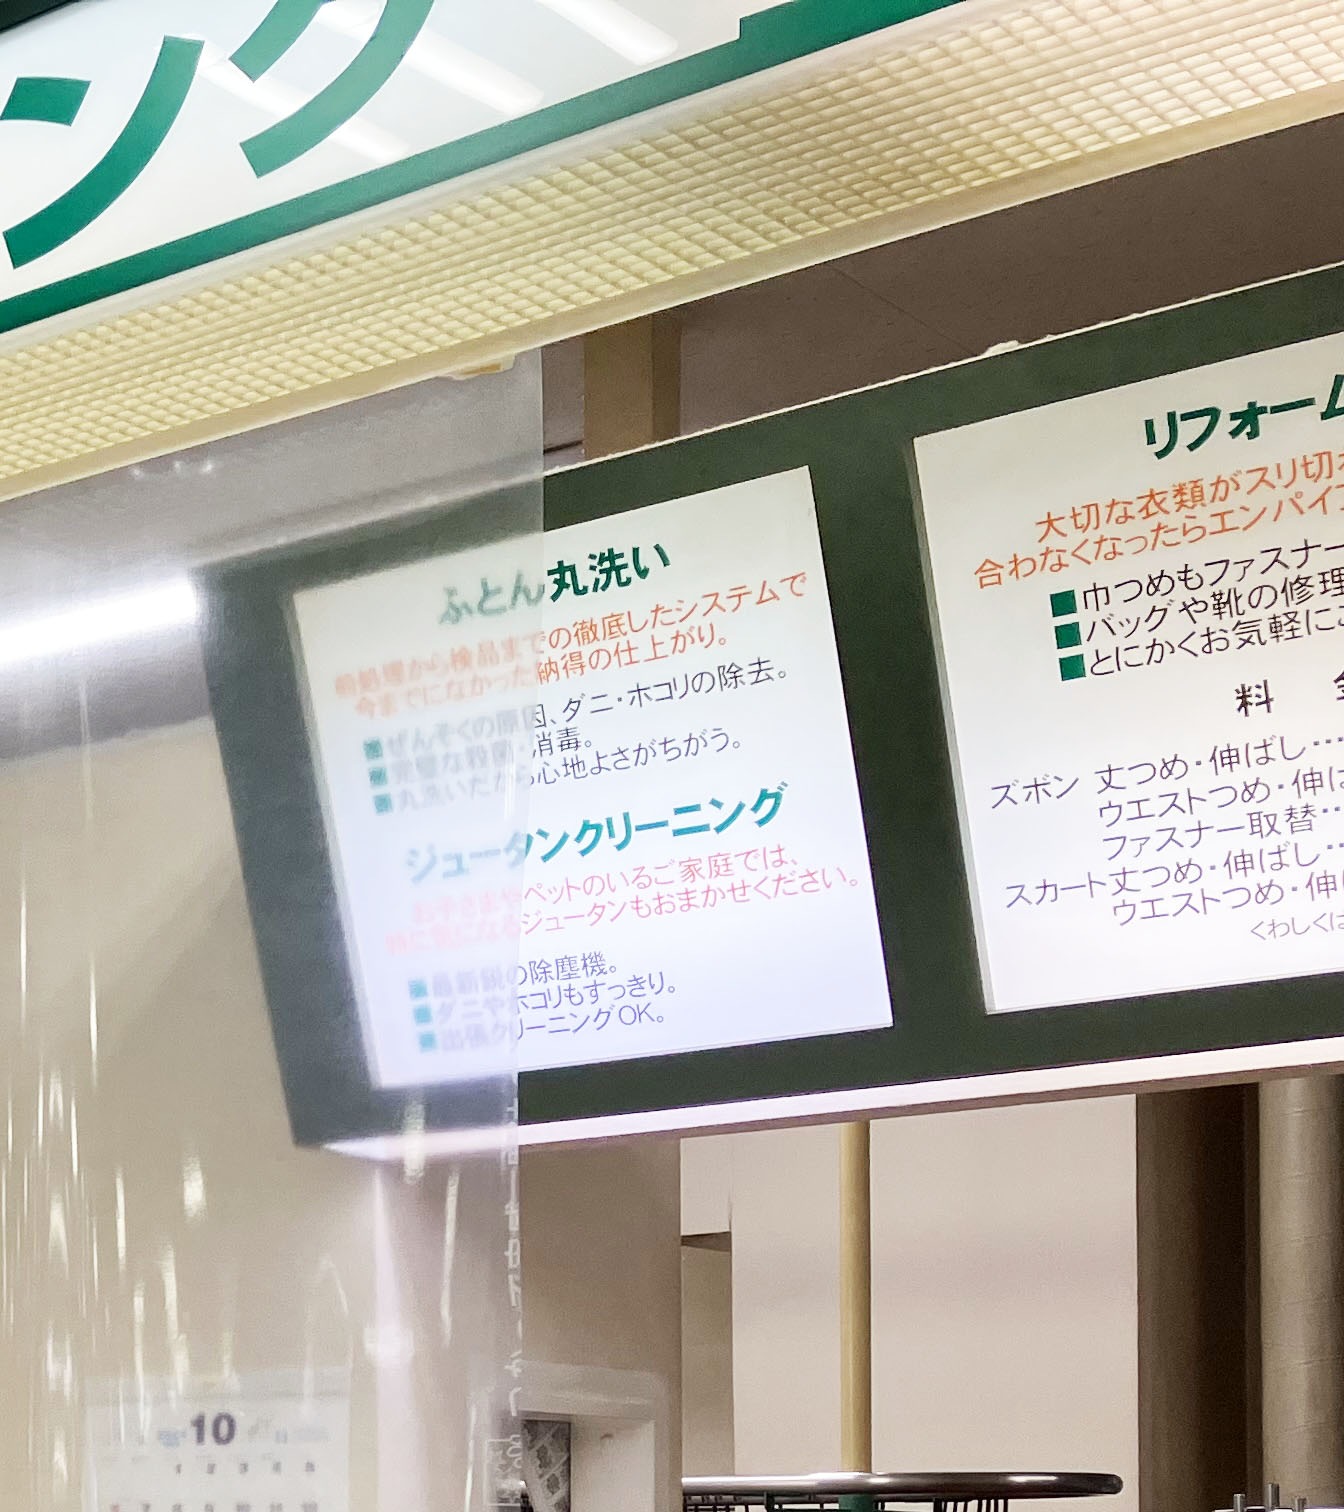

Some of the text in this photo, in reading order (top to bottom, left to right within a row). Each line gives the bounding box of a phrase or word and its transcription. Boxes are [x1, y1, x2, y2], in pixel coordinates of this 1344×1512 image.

[1036, 450, 1344, 545] 大切な衣類がスリ切
[974, 486, 1344, 589] 合わなくなったらエンパイ
[439, 543, 671, 624] ふとん丸洗い
[1088, 605, 1344, 678] とにかくお気軽に
[991, 775, 1080, 810] ズボン
[407, 780, 790, 885] ジュータンクリーニング
[1112, 864, 1344, 928] ウエストつめ・伸
[191, 1412, 236, 1446] 10
